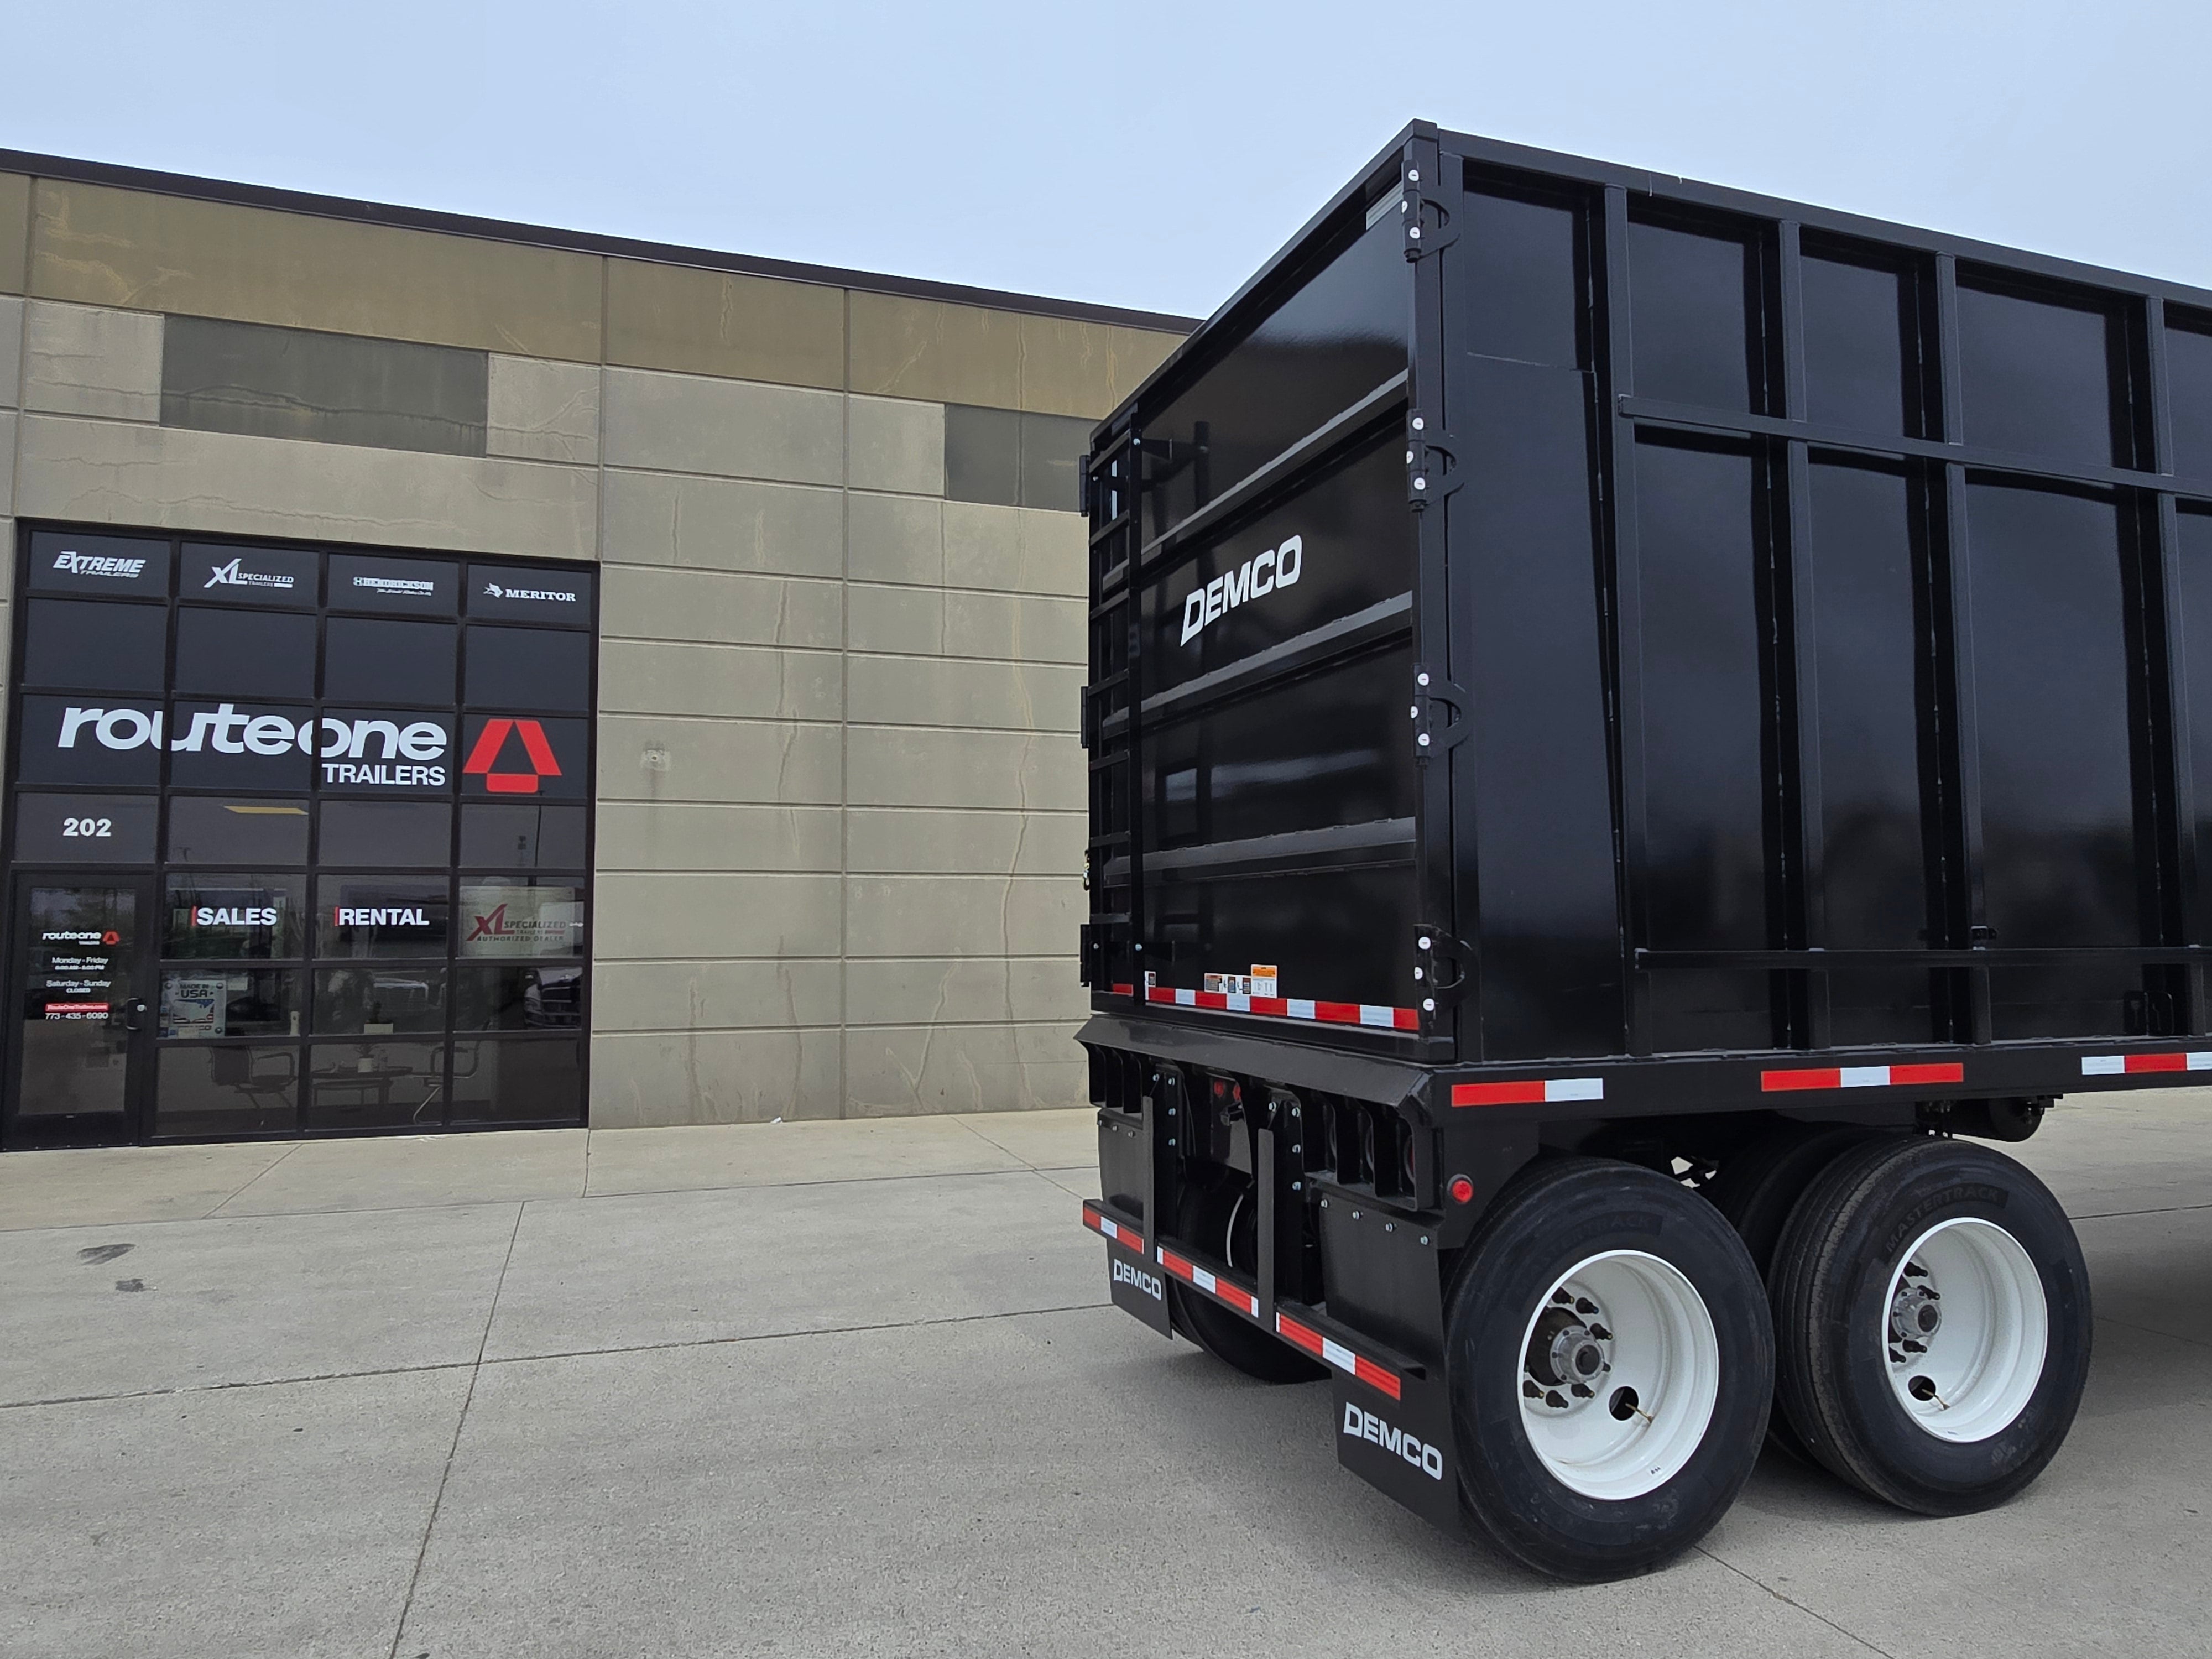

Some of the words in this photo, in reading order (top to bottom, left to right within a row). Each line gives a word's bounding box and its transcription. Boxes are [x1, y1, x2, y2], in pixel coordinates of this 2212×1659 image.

[53, 551, 146, 574] EXTREME
[204, 558, 248, 588] XL
[238, 573, 294, 583] SPECIALIZED
[505, 589, 576, 602] MERITOR
[1180, 535, 1302, 646] DEMCO
[58, 704, 447, 760] routeone
[322, 764, 445, 786] TRAILERS
[63, 818, 112, 837] 202
[196, 907, 277, 926] SALES
[339, 909, 430, 926] RENTAL
[466, 904, 515, 941] XL
[504, 920, 566, 930] SPECIALIZED
[180, 989, 208, 998] USA
[1884, 1186, 1999, 1253] MASTERTRACK
[1113, 1258, 1162, 1301] DEMCO
[1344, 1402, 1442, 1480] DEMCO
